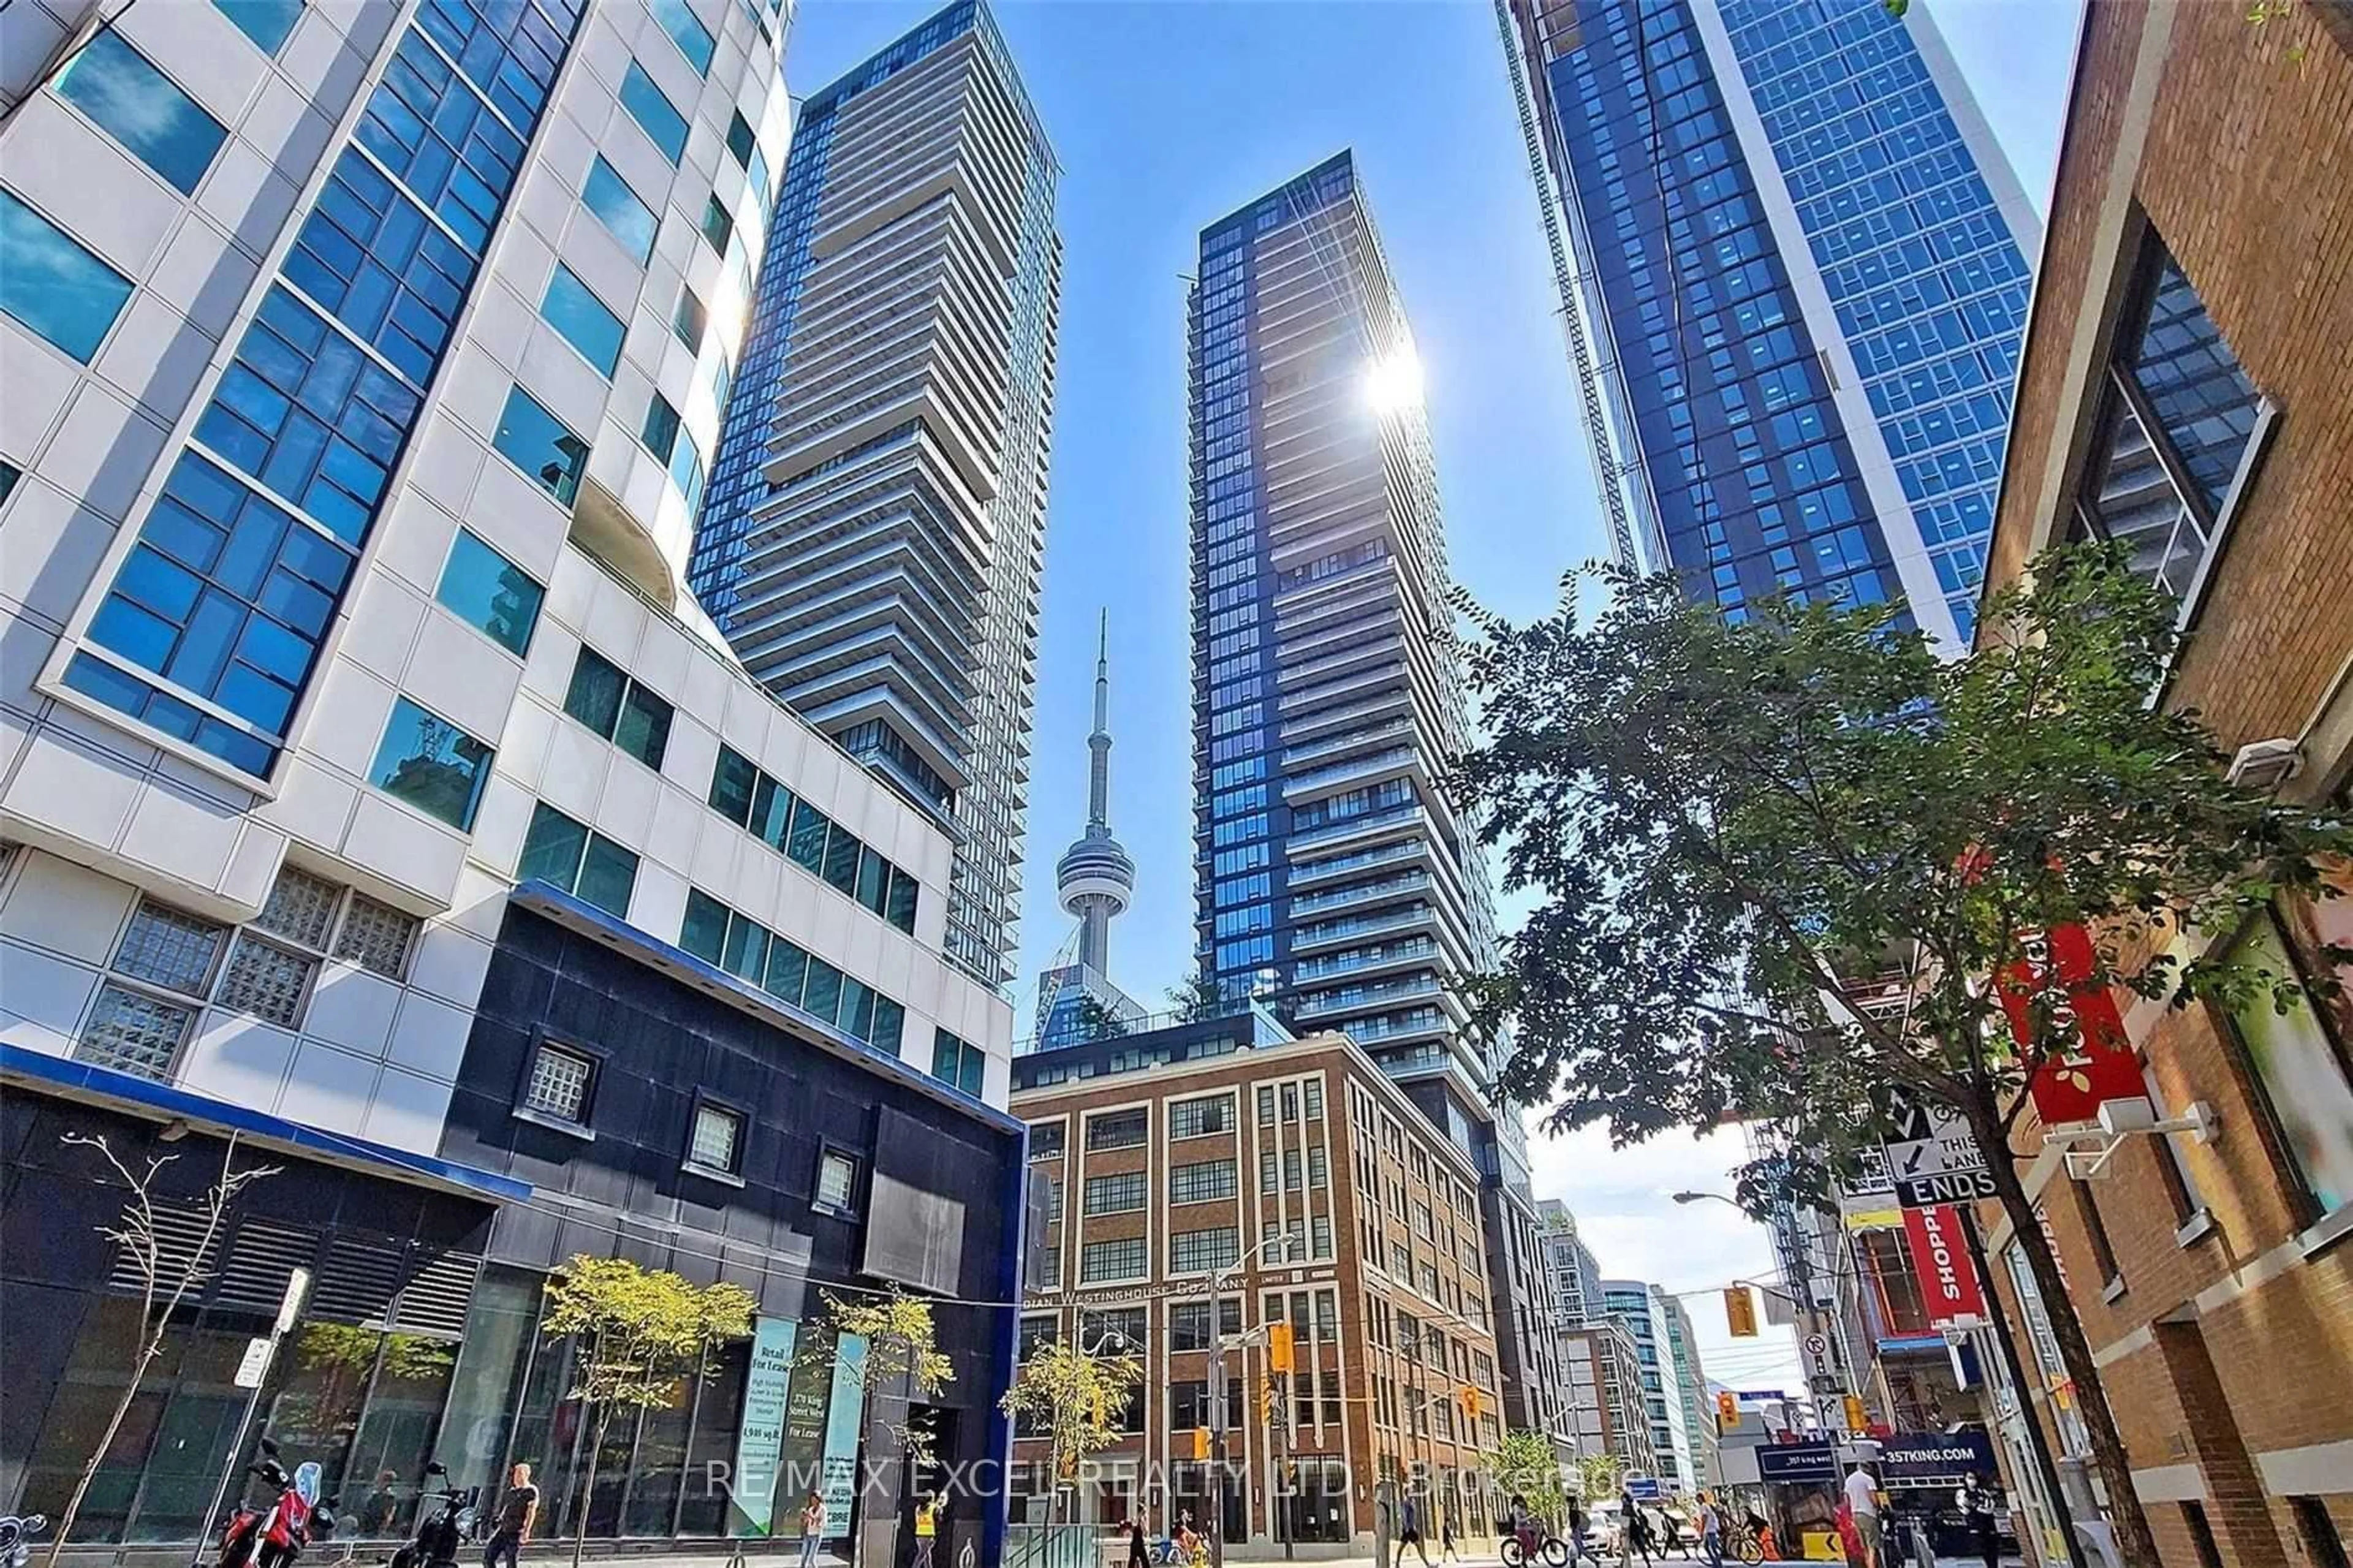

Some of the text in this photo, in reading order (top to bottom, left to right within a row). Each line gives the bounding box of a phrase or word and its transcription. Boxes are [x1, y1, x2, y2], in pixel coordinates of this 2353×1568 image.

[1940, 1134, 1979, 1152] THIS
[1941, 1151, 1987, 1170] LANE
[1912, 1171, 1997, 1203] ENDS
[1060, 1285, 1170, 1306] WESTINGHOUSE
[752, 1358, 767, 1369] For
[1886, 1448, 1976, 1463] 357KING.COM
